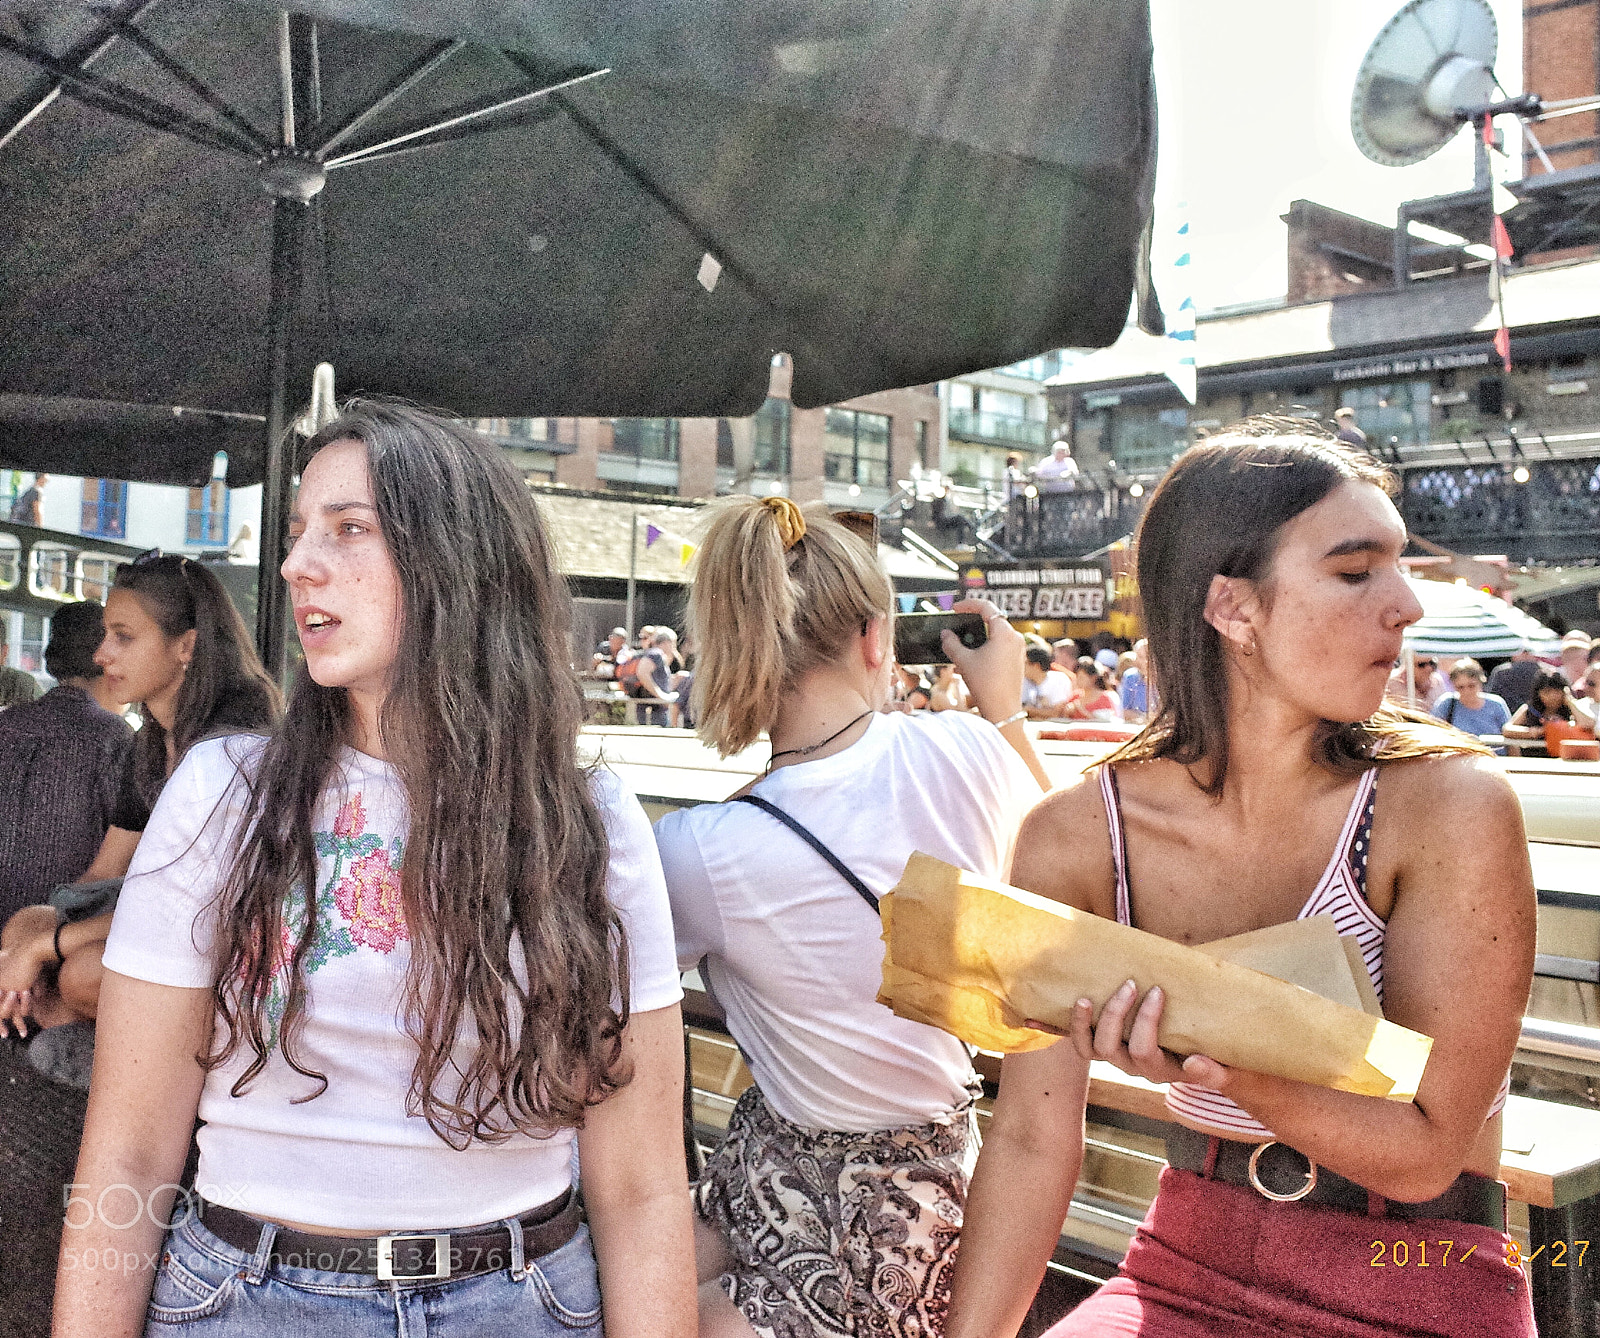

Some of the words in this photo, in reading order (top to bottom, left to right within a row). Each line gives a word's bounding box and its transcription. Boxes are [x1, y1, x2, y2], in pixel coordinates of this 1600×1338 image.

[1393, 360, 1418, 374] Bar
[1419, 357, 1431, 370] &
[1040, 568, 1074, 585] STREET
[1075, 568, 1102, 584] FOOD
[1034, 587, 1105, 617] BLAZE
